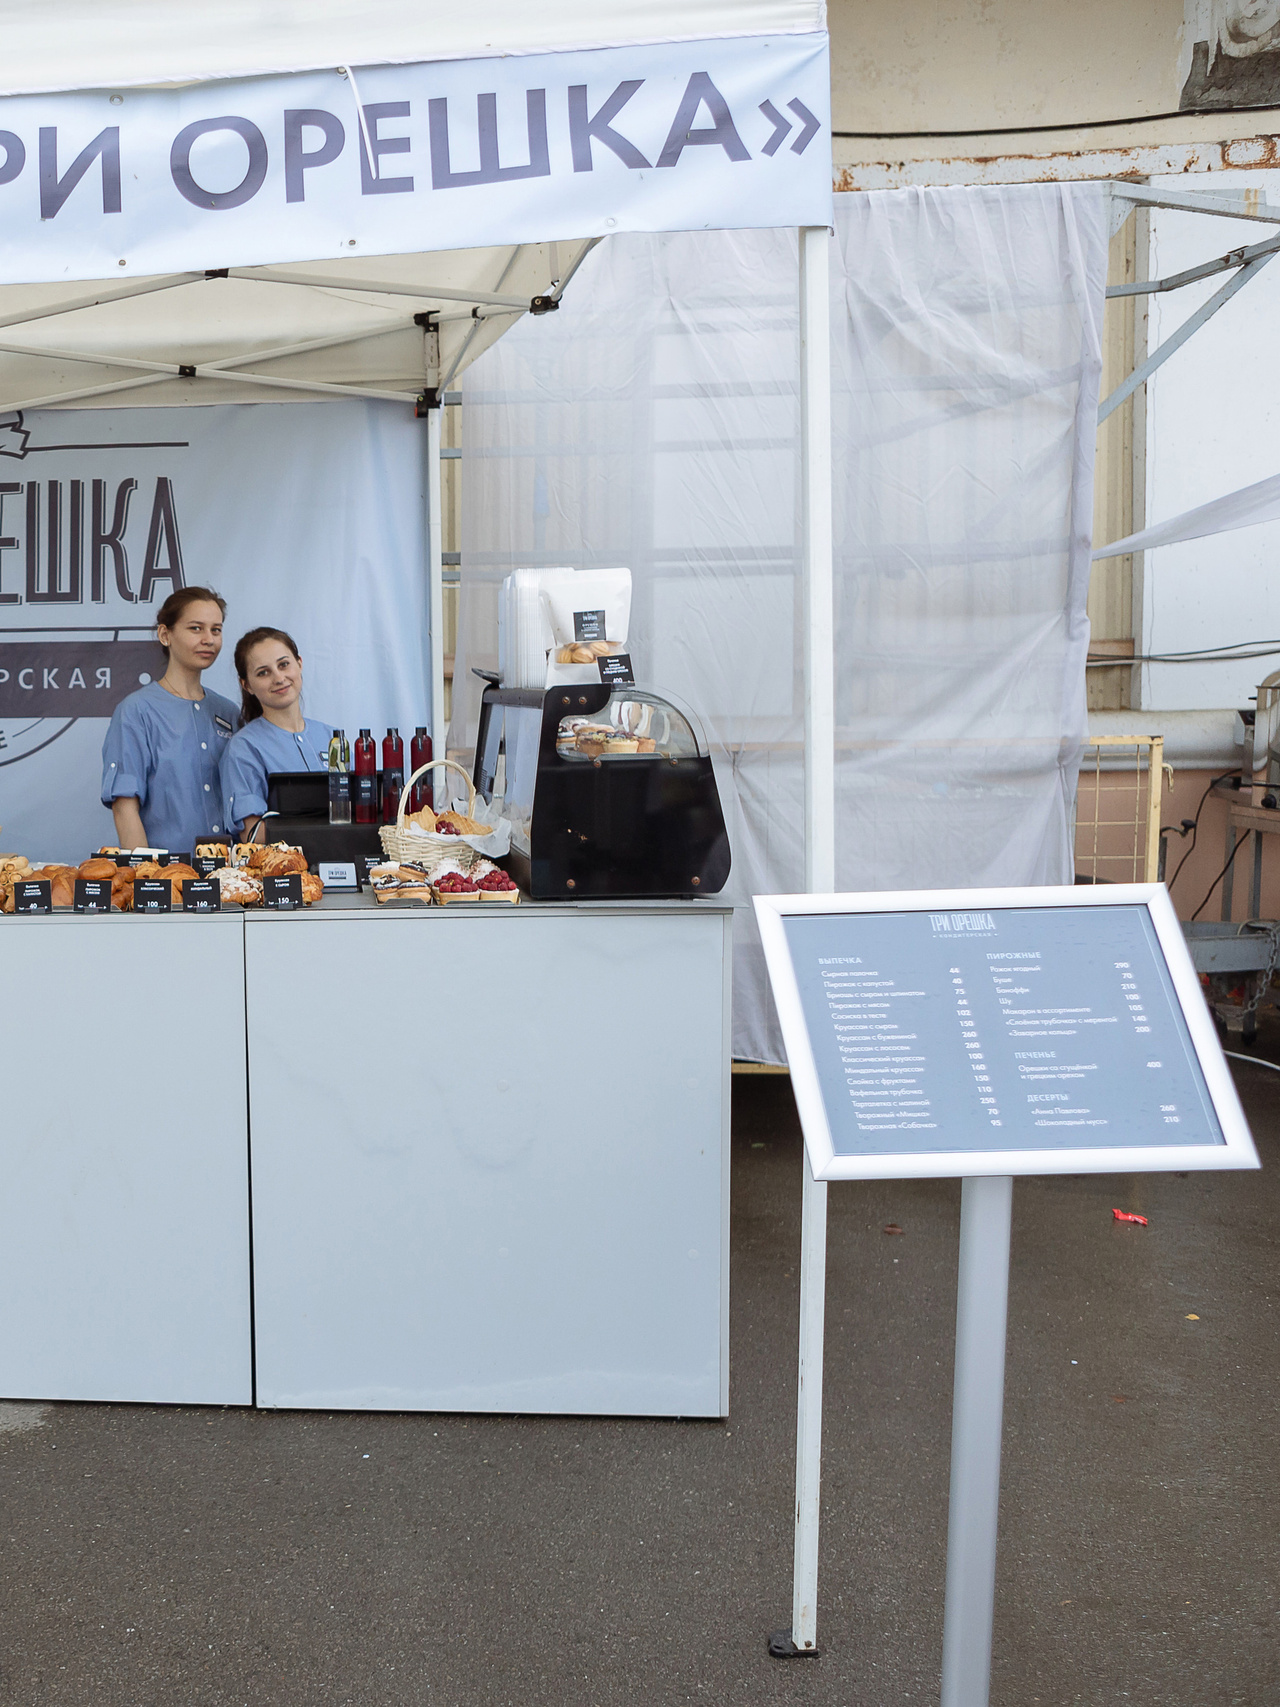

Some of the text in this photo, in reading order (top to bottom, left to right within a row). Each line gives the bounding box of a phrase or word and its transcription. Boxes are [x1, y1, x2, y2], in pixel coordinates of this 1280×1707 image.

[169, 71, 823, 212] ОРЕШКА»
[928, 913, 996, 931] ТРИ ОРЕШКА
[986, 952, 1041, 960] ПИРОЖНЫЕ
[829, 1002, 861, 1010] Пирожок
[1015, 1051, 1056, 1059] ПЕЧЕНЬЕ
[1027, 1094, 1068, 1102] ДЕСЕРТЫ
